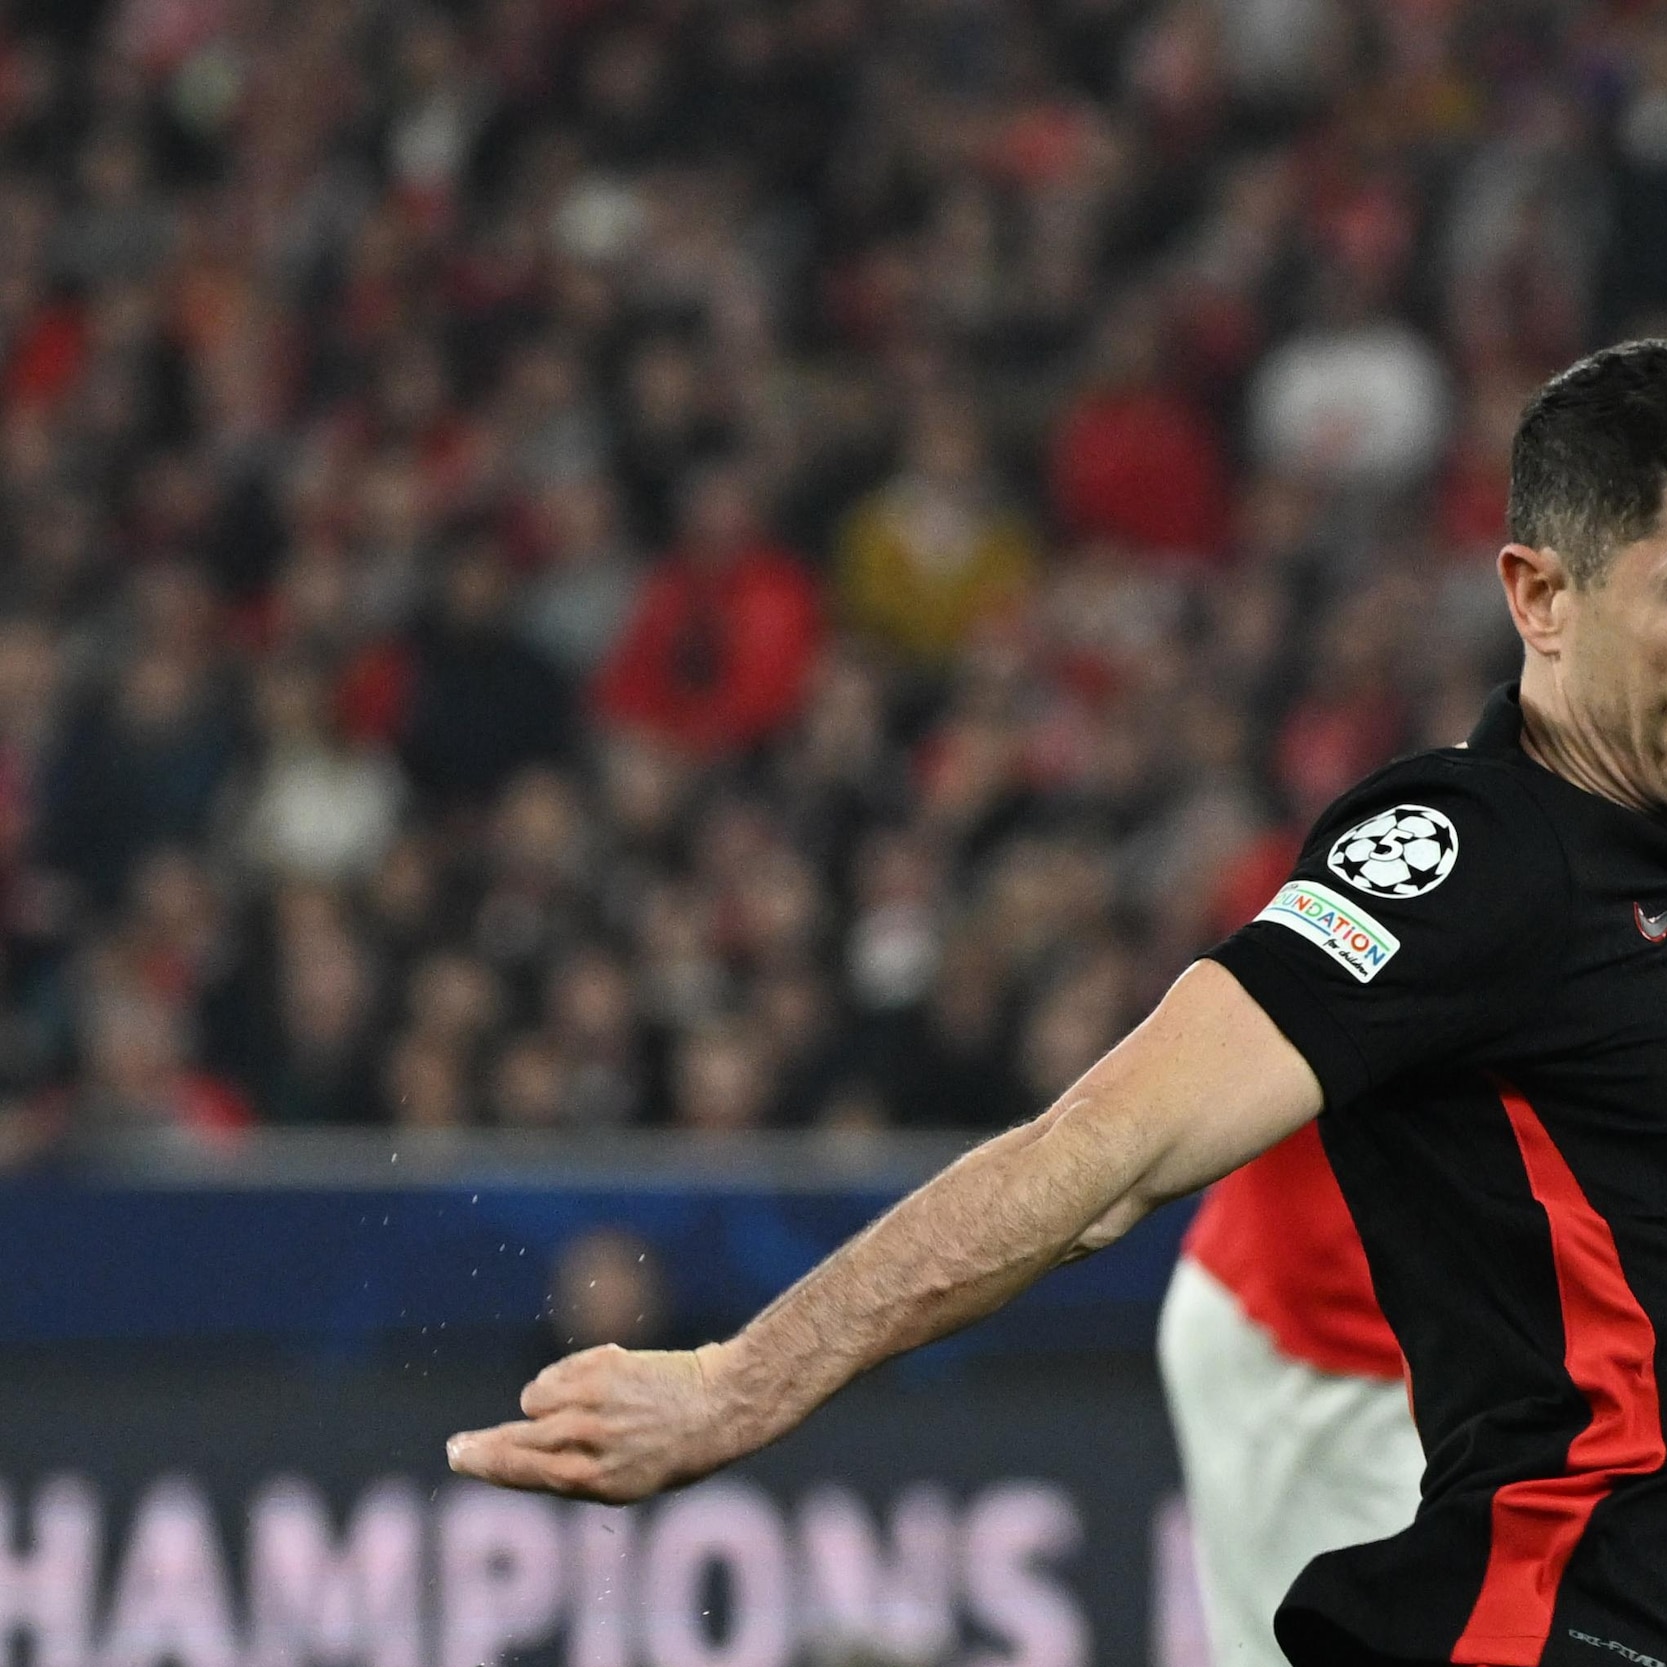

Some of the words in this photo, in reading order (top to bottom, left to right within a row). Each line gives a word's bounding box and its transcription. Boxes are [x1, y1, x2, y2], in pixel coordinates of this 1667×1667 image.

[1368, 828, 1415, 862] 5
[1323, 938, 1340, 951] for
[1338, 949, 1369, 977] children
